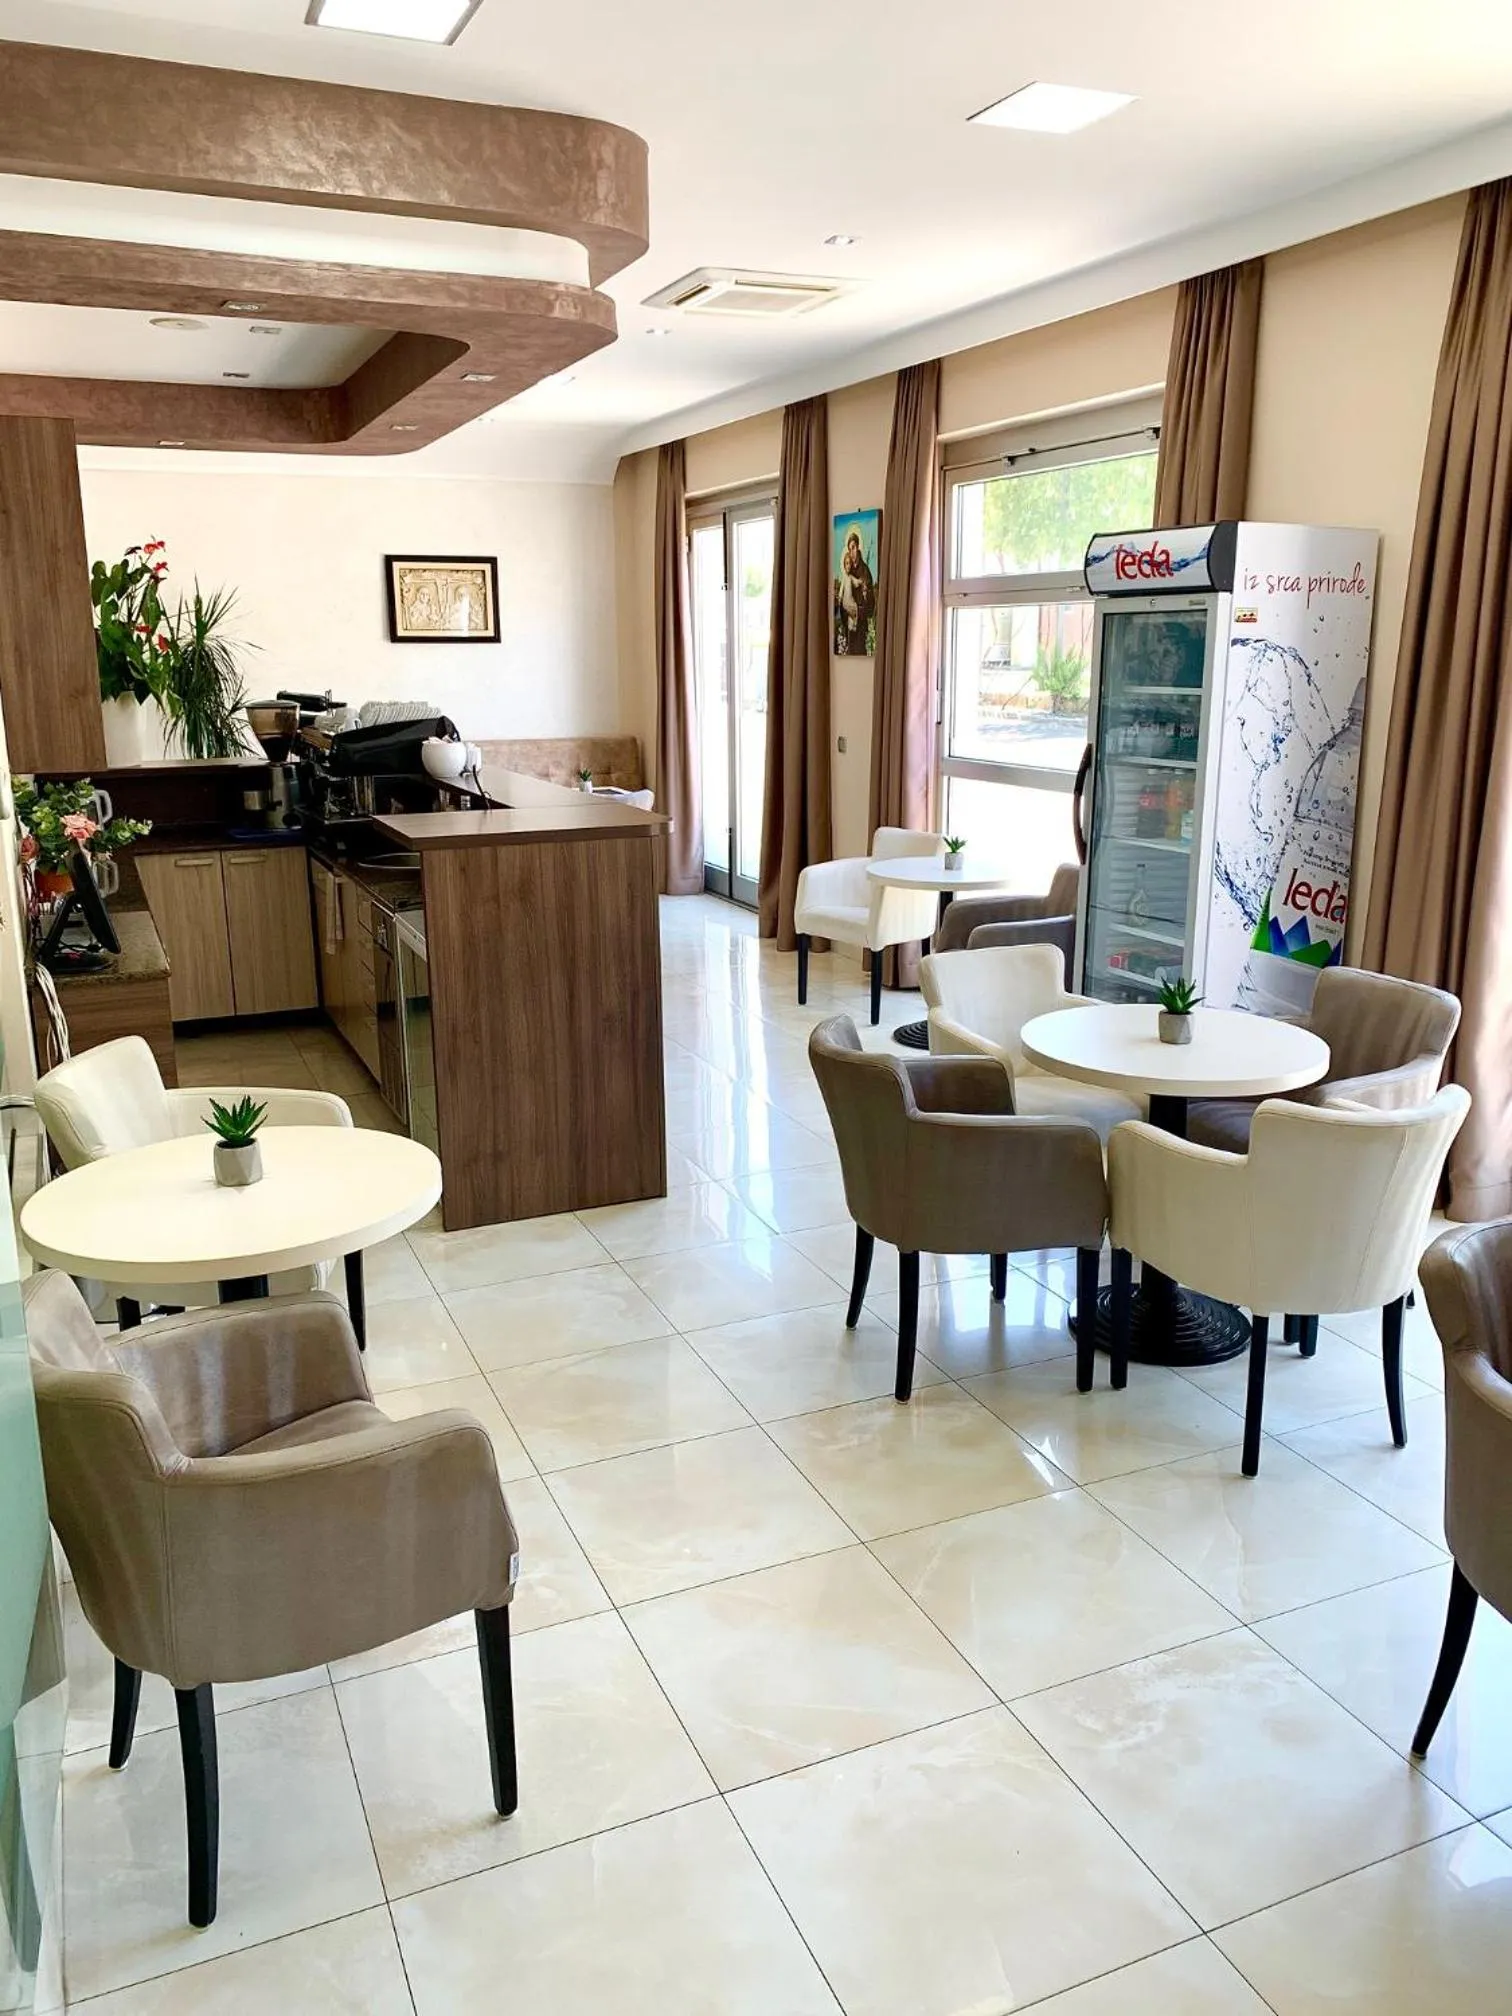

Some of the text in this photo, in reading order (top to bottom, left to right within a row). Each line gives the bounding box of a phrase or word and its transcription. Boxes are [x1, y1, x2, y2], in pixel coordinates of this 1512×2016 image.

[1244, 567, 1260, 590] iz
[1266, 575, 1302, 594] srca
[1283, 868, 1347, 924] leda
